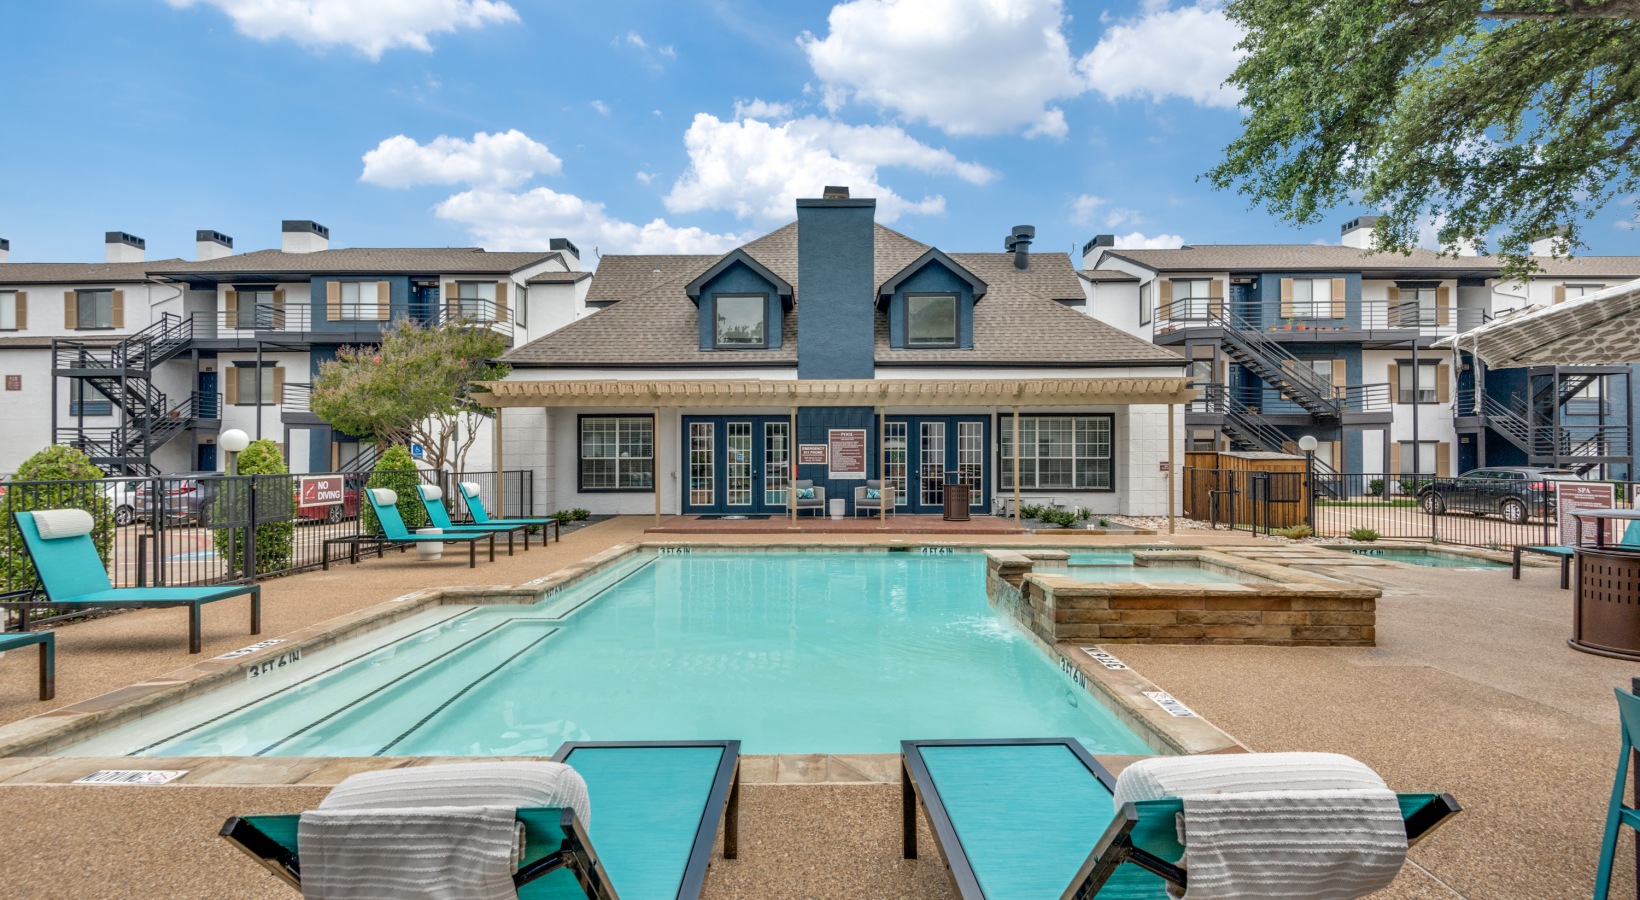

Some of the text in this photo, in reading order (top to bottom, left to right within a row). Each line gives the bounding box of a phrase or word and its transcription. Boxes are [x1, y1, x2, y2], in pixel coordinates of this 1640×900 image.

[317, 481, 329, 490] NO
[317, 490, 341, 500] DIVING
[249, 650, 300, 678] 3 FT 6 IN
